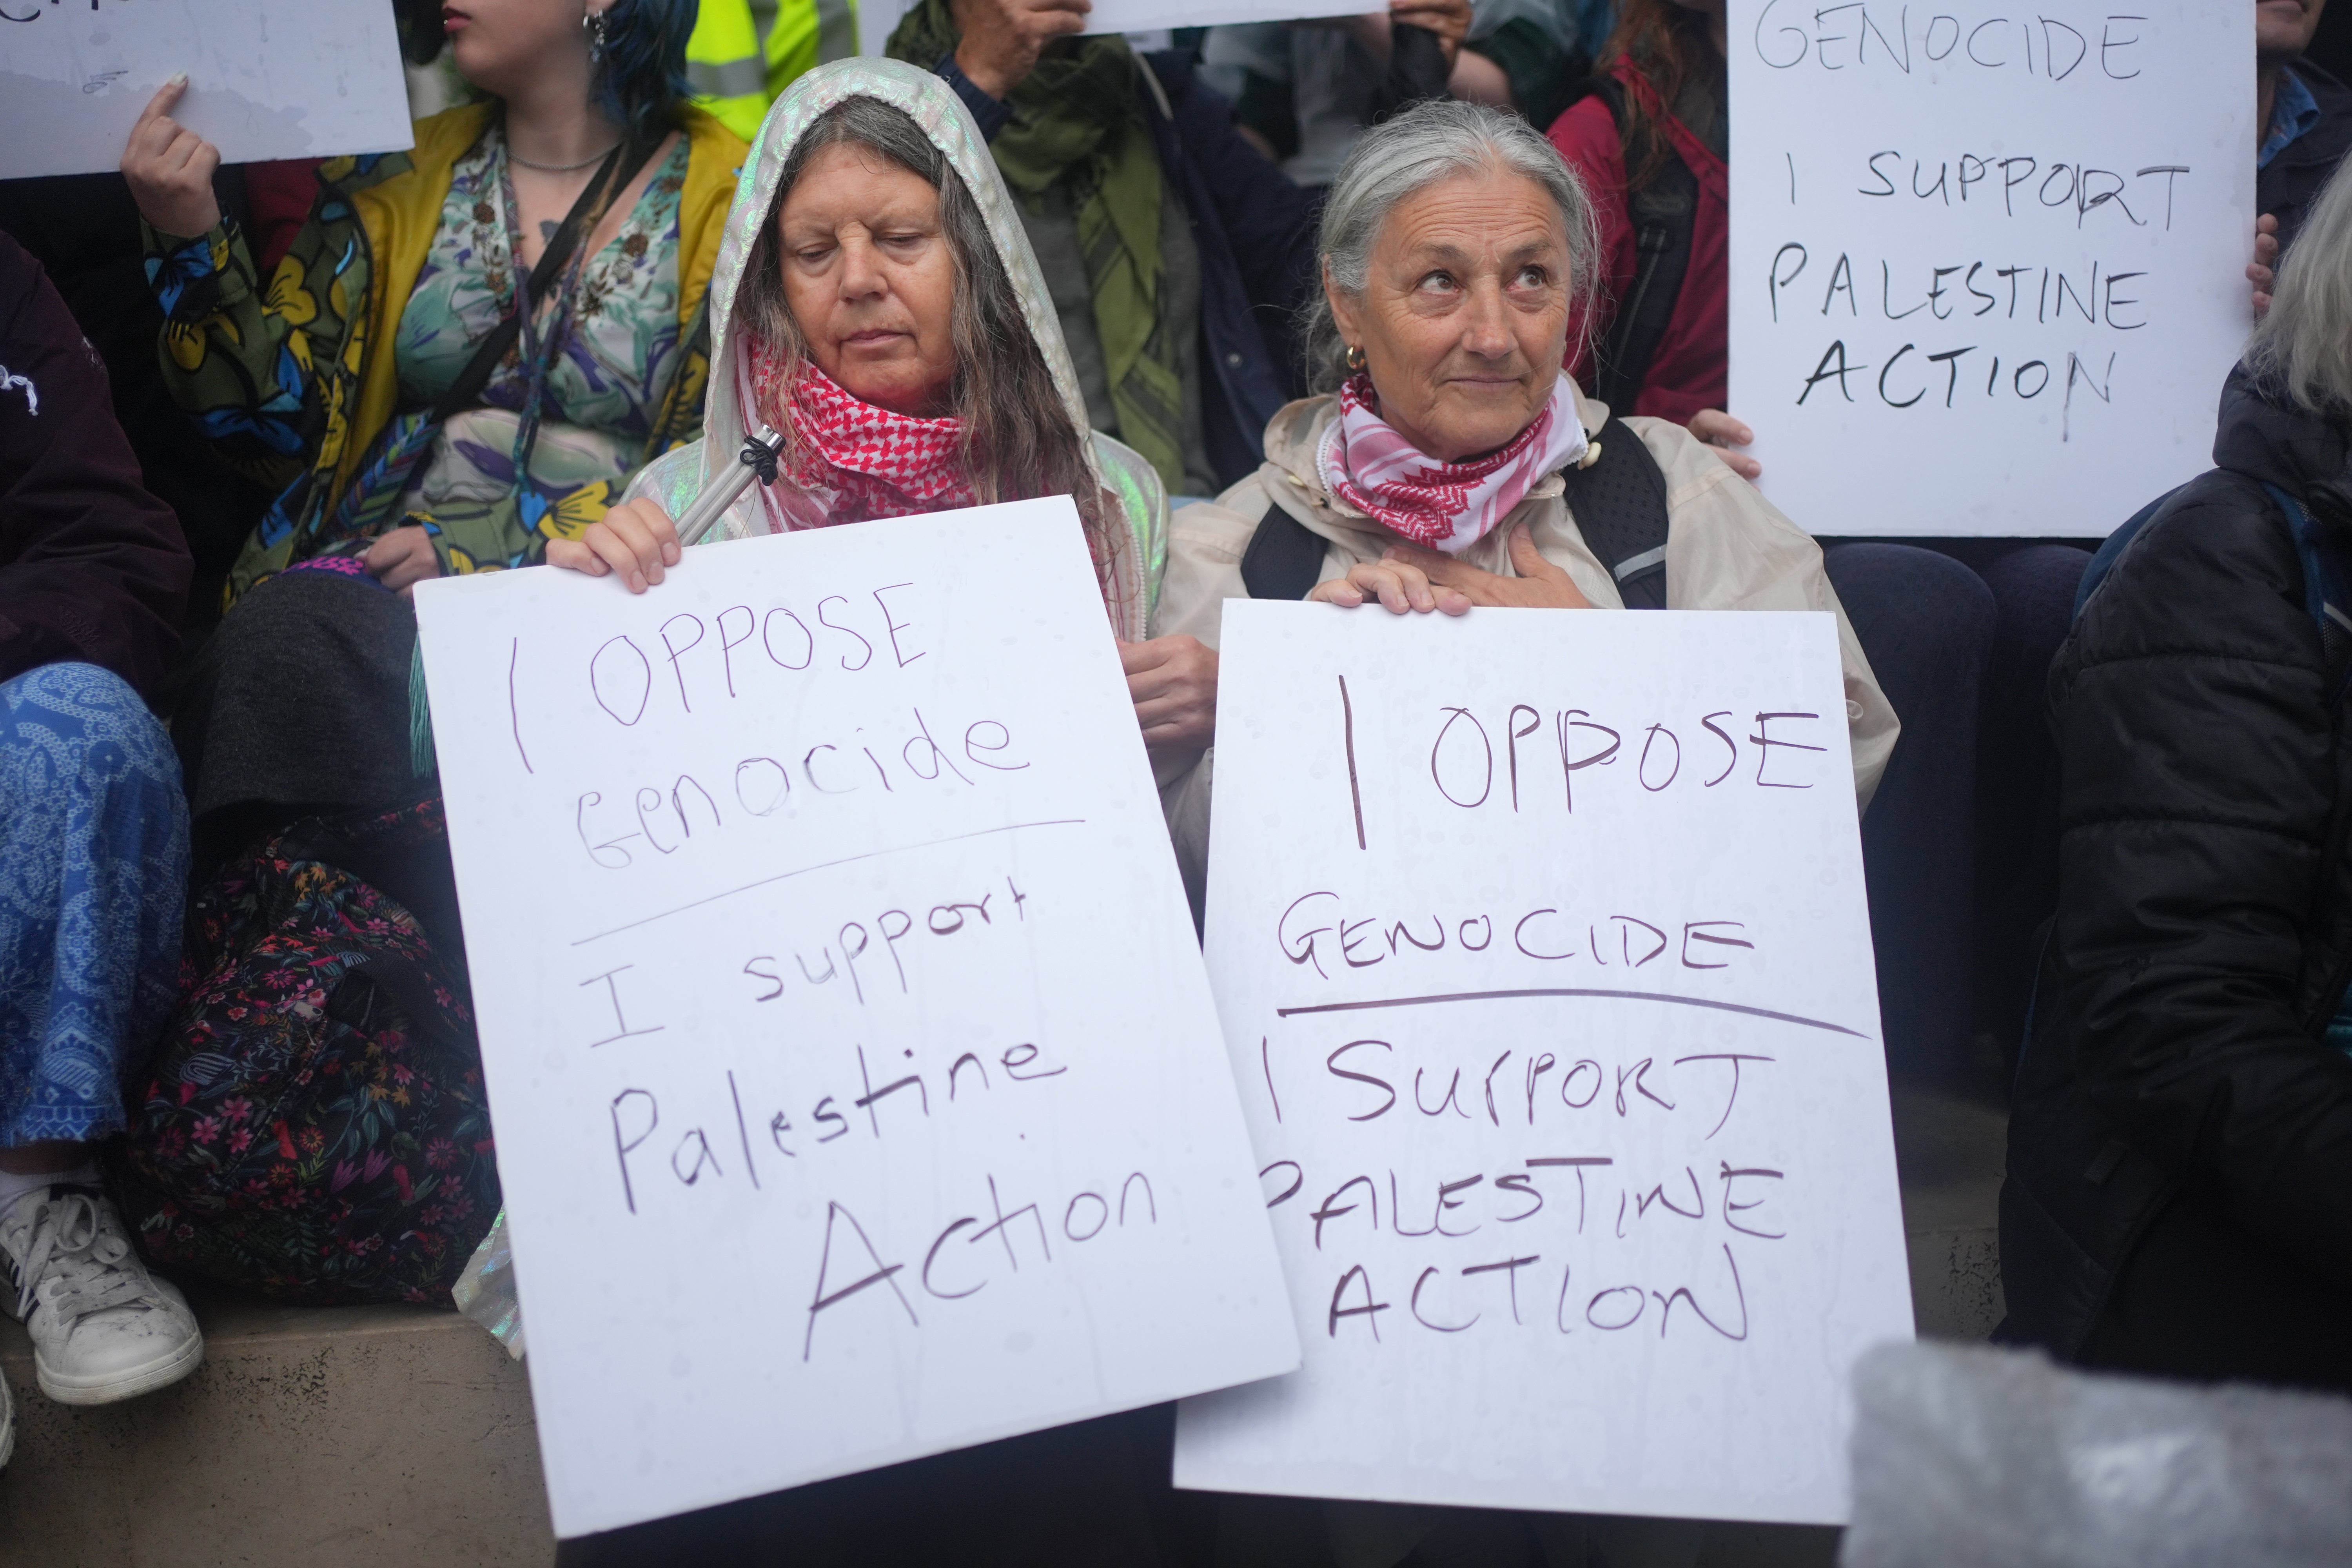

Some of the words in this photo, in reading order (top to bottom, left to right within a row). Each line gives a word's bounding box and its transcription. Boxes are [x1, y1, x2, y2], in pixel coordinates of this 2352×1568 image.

[1755, 0, 2148, 81] GENOCIDE
[1786, 152, 1796, 204] I
[1858, 151, 2190, 230] SUPPORT
[1769, 242, 2148, 329] PALESTINE
[1796, 340, 2116, 443] ACTION
[509, 637, 534, 774] I
[590, 582, 927, 726] OPPOSE
[577, 707, 1030, 869] Genocide
[1338, 675, 1366, 850] I
[1431, 704, 1828, 813] OPPOSE
[579, 964, 665, 1049] I
[742, 876, 1026, 1004] support
[1278, 891, 1755, 980] GENOCIDE
[610, 1044, 1068, 1215] Palestine
[1262, 1035, 1281, 1123] I
[1327, 1040, 1776, 1139] SUPPORT
[803, 1172, 1156, 1362] Action
[1328, 1242, 1747, 1342] ACTION
